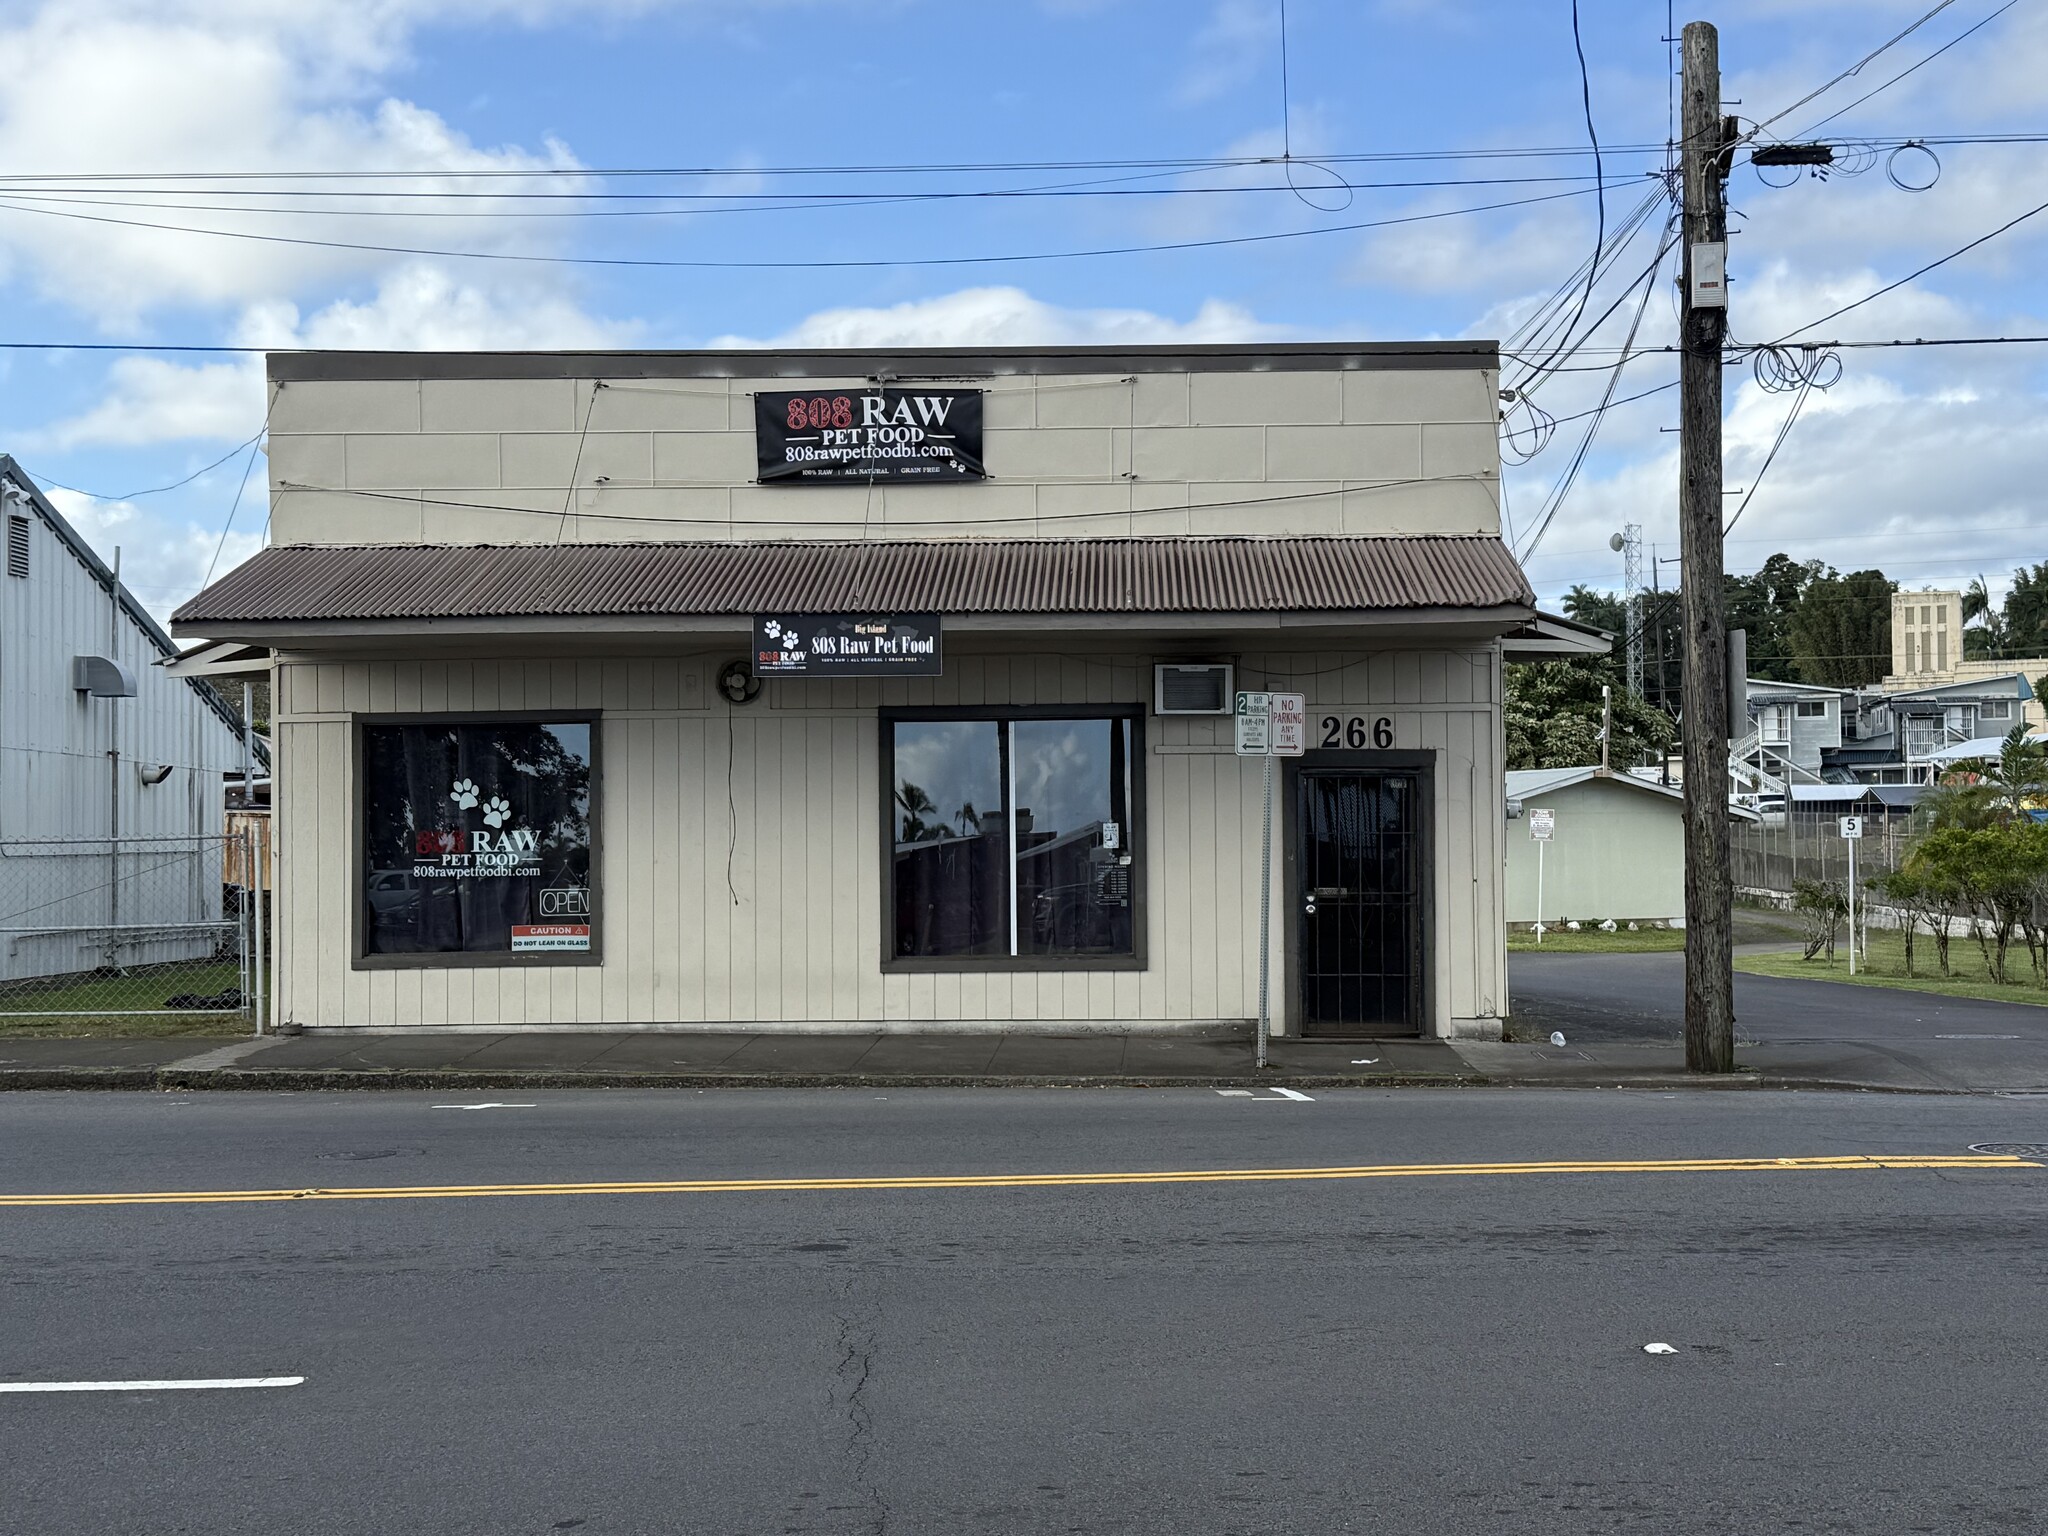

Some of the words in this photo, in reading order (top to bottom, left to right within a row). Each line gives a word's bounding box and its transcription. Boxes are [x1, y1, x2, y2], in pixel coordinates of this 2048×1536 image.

[786, 396, 852, 430] 808
[859, 396, 955, 427] RAW
[821, 429, 862, 446] PET
[866, 426, 925, 444] FOOD
[785, 442, 954, 463] 808rawpetfoodbi.com
[854, 624, 866, 635] Big
[867, 624, 887, 634] Island
[811, 636, 836, 655] 808
[840, 636, 871, 654] Raw
[874, 636, 899, 654] Pet
[902, 635, 934, 654] Food
[759, 651, 779, 661] 808
[780, 651, 807, 661] RAW
[1238, 696, 1246, 712] 2
[1253, 696, 1263, 704] HR
[1247, 705, 1268, 713] PARKING
[1281, 699, 1294, 711] NO
[1273, 712, 1302, 724] PARKING
[1281, 725, 1295, 733] ANY
[1321, 716, 1393, 749] 266
[1280, 734, 1296, 742] TIME
[1847, 818, 1856, 831] 5
[470, 830, 542, 853] RAW
[441, 853, 471, 866] PET
[475, 853, 519, 866] FOOD
[413, 865, 541, 880] 808rawpetfoodbi.com
[542, 891, 590, 913] OPEN
[530, 927, 572, 935] CAUTION
